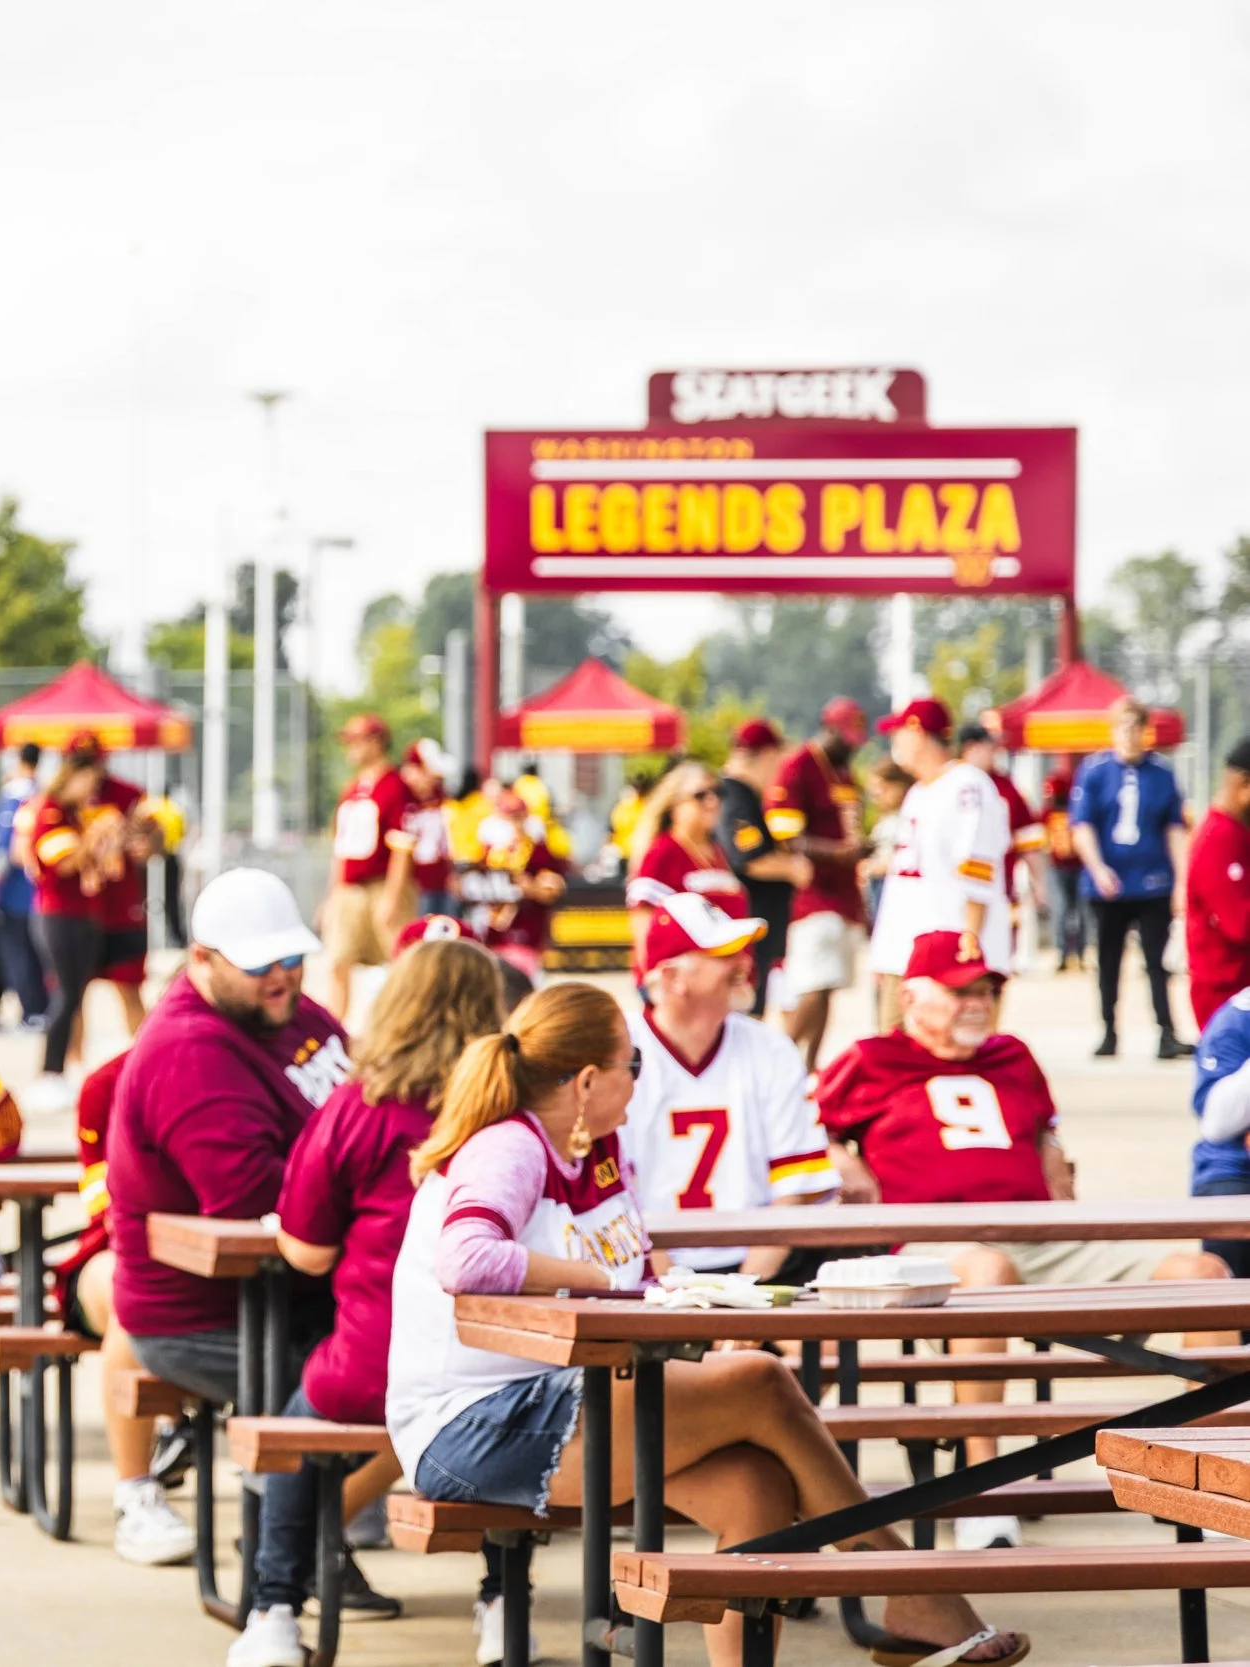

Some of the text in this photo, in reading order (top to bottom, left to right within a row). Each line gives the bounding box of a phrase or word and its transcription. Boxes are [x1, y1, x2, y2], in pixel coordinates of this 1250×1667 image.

[670, 371, 898, 424] SEATGEEK
[531, 483, 1021, 554] LEGENDS PLAZA
[925, 1075, 1013, 1151] 9
[670, 1107, 730, 1211] 7
